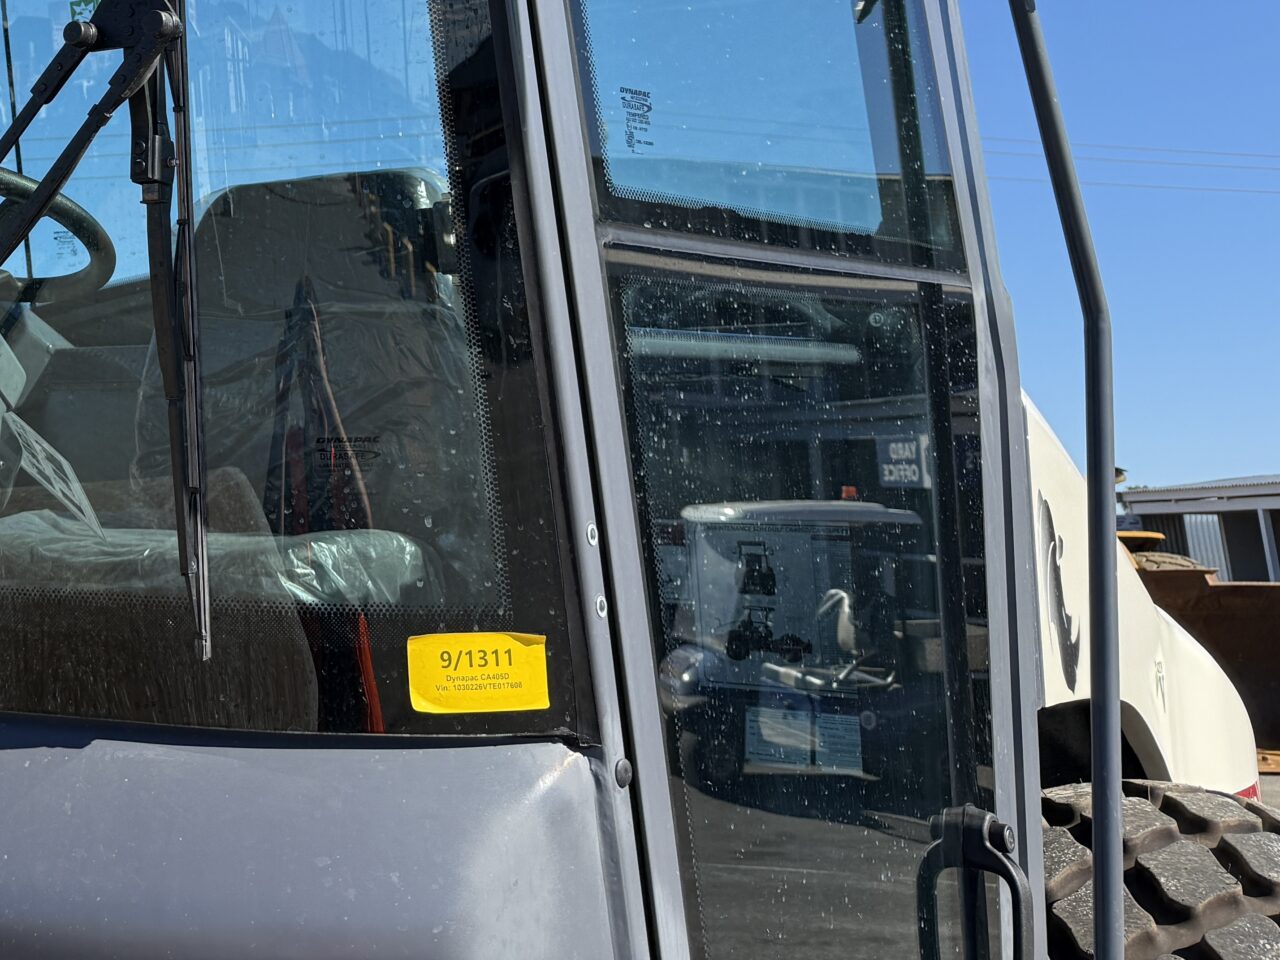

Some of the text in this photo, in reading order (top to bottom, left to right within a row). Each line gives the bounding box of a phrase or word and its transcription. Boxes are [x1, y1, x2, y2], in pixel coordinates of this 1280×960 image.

[316, 435, 381, 444] DYNAPAC
[440, 648, 513, 671] 9/1311
[446, 675, 479, 683] Dynapac
